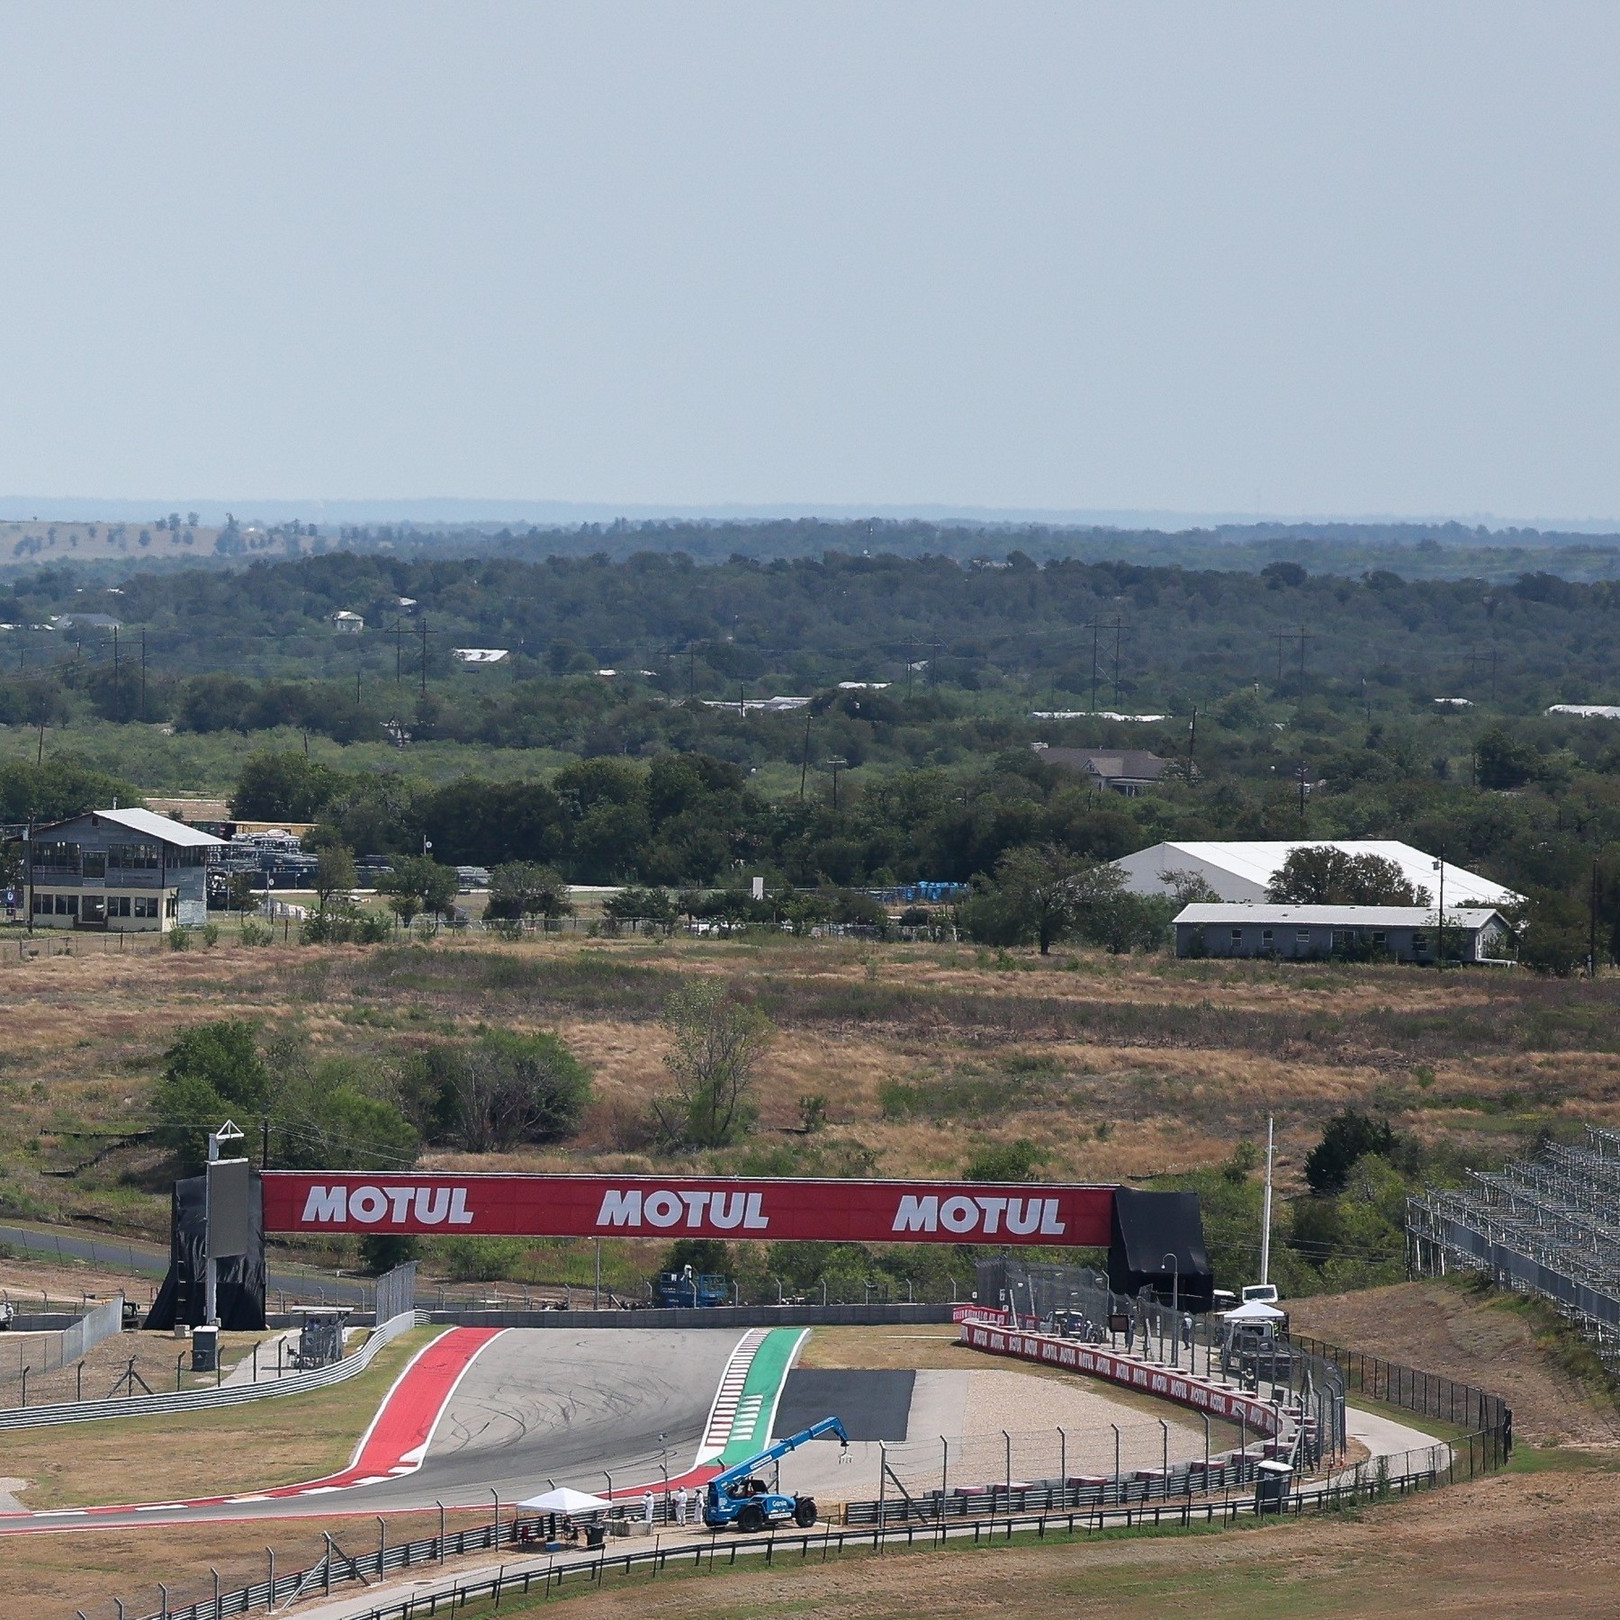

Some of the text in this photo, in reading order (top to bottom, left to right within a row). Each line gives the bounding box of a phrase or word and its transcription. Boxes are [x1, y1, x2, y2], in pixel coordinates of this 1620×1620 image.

[302, 1187, 1065, 1235] MOTUL MOTUL MOTUL
